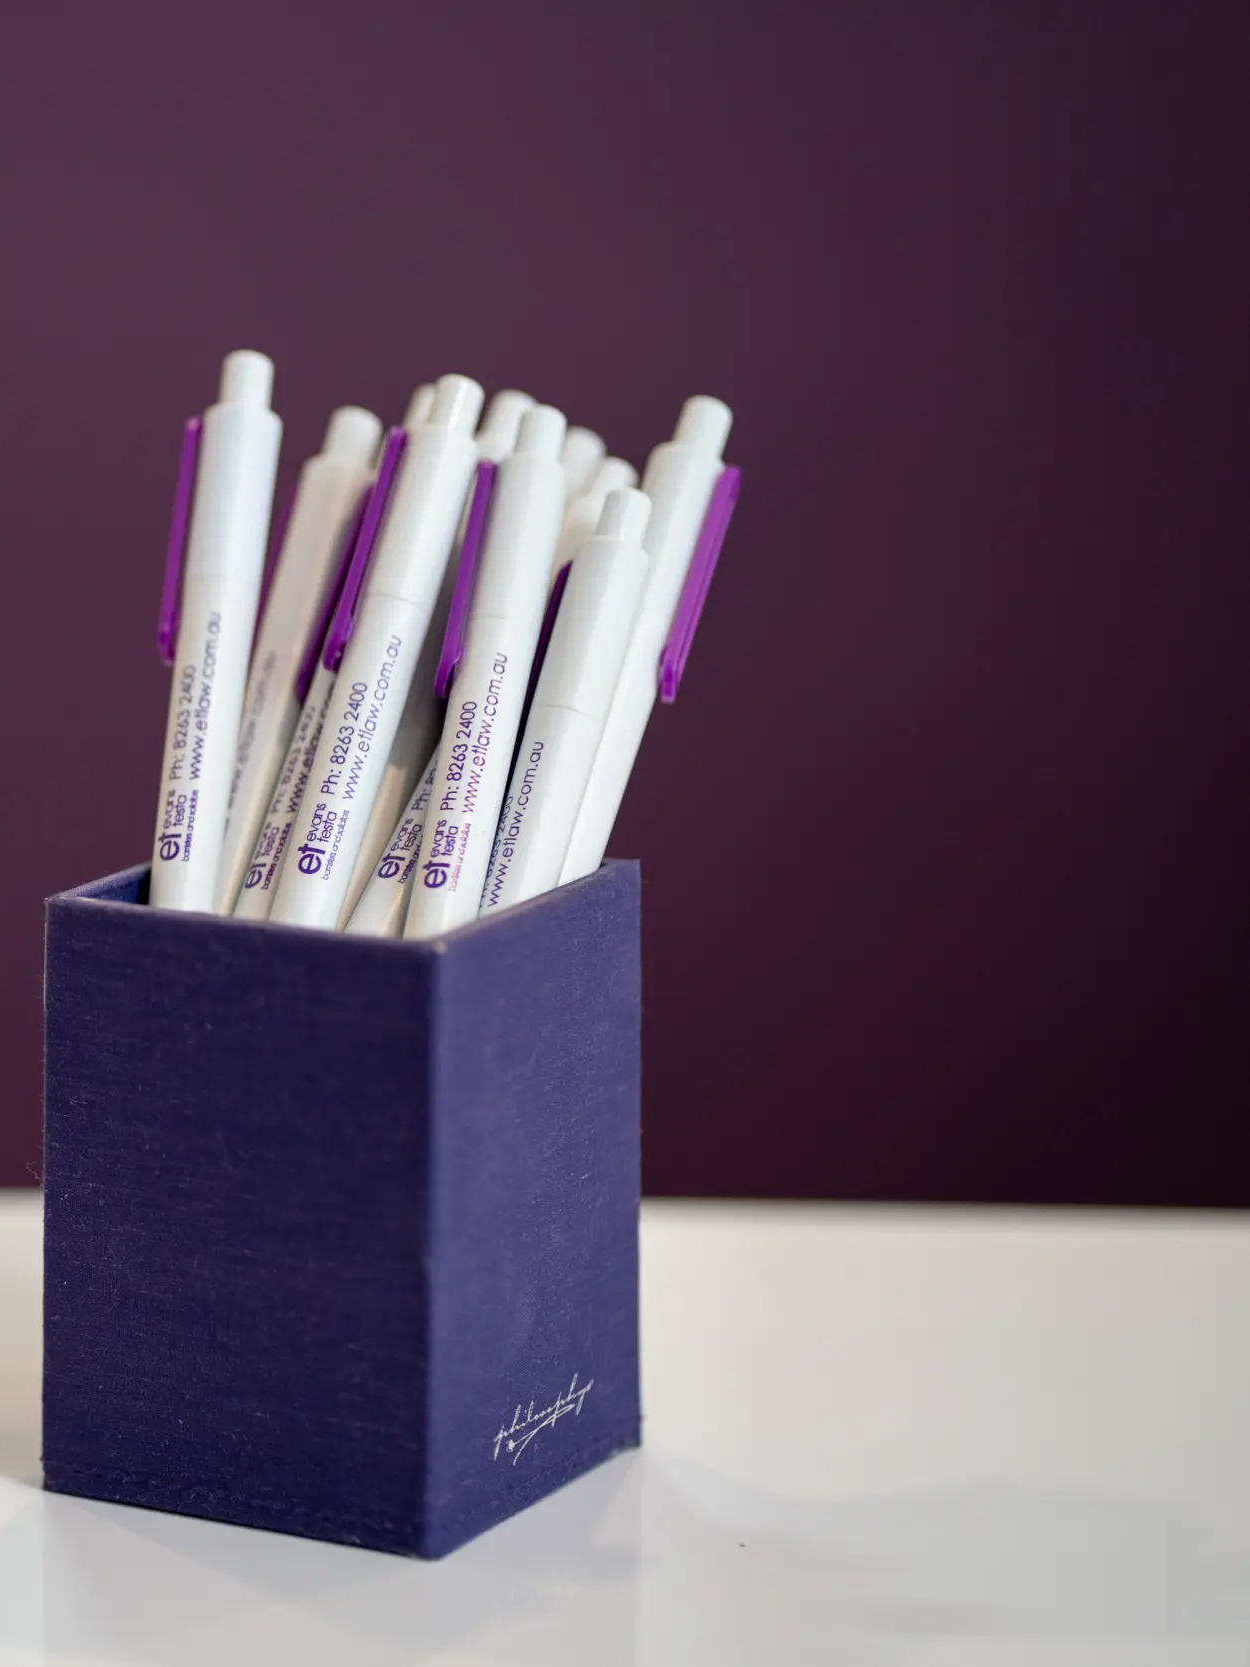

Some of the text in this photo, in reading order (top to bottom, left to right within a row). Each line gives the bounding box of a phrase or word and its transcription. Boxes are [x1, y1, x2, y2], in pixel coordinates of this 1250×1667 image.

[189, 612, 222, 780] www.etlaw.com.au
[169, 664, 196, 781] Ph: 8263 2400
[342, 634, 402, 800] www.etlaw.com.au
[462, 652, 508, 813] www.etlaw.com.au
[320, 681, 368, 795] Ph: 8263 2400
[439, 701, 478, 811] Ph: 8263 2400
[163, 789, 176, 829] evans
[173, 794, 187, 827] testa
[306, 803, 327, 842] evans
[317, 811, 337, 844] testa
[486, 741, 544, 907] www.etlaw.com.au
[159, 829, 182, 861] et
[390, 818, 414, 852] evans
[400, 823, 422, 852] testa
[430, 819, 447, 857] evans
[441, 825, 459, 856] testa
[297, 843, 326, 875] et
[378, 853, 406, 879] et
[422, 860, 451, 889] et
